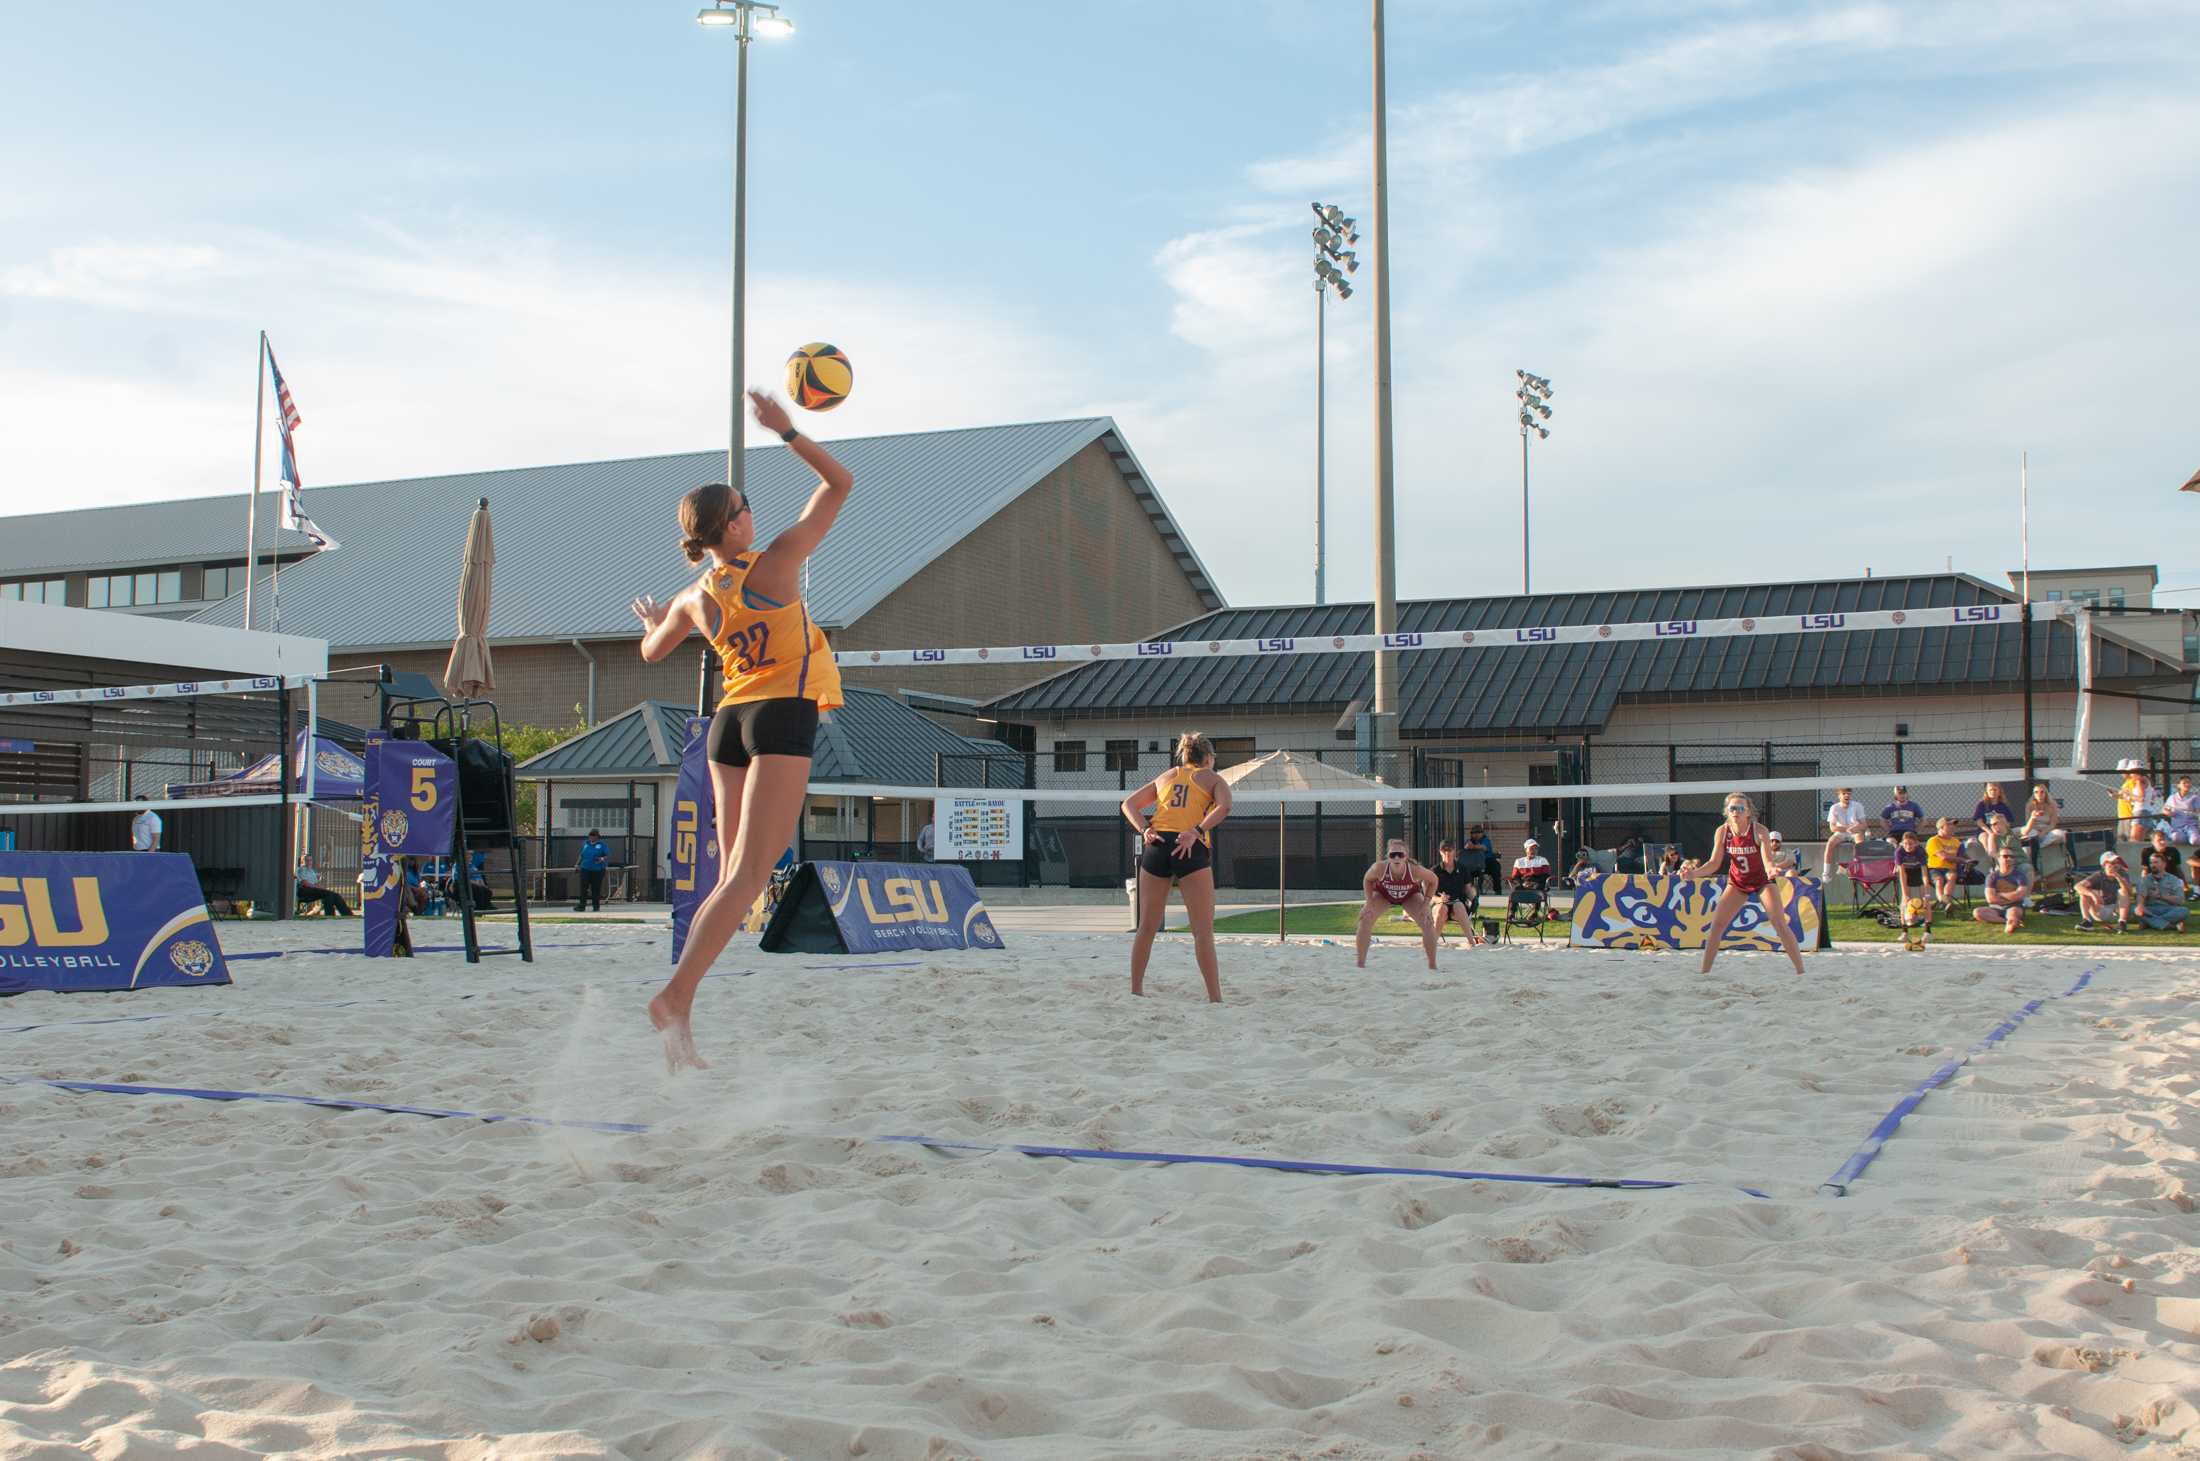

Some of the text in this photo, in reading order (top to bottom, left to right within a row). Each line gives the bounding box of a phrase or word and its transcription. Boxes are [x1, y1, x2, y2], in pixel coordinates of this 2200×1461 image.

[1954, 606, 2000, 622] LSU
[1655, 622, 1697, 636] LSU
[1801, 615, 1845, 629] LSU
[1384, 634, 1422, 648] LSU
[1516, 628, 1557, 642] LSU
[727, 621, 777, 674] 32
[1023, 646, 1056, 659] LSU
[1137, 643, 1173, 656] LSU
[1258, 639, 1294, 652] LSU
[913, 649, 945, 662] LSU
[176, 682, 199, 693] LSU
[252, 678, 276, 689] LSU
[33, 692, 55, 702] LSU
[103, 688, 125, 698] LSU
[410, 767, 437, 812] 5
[1171, 784, 1189, 808] 31
[675, 800, 698, 891] LSU
[1736, 856, 1750, 873] 3
[857, 878, 949, 924] LSU
[874, 928, 906, 938] BEACH
